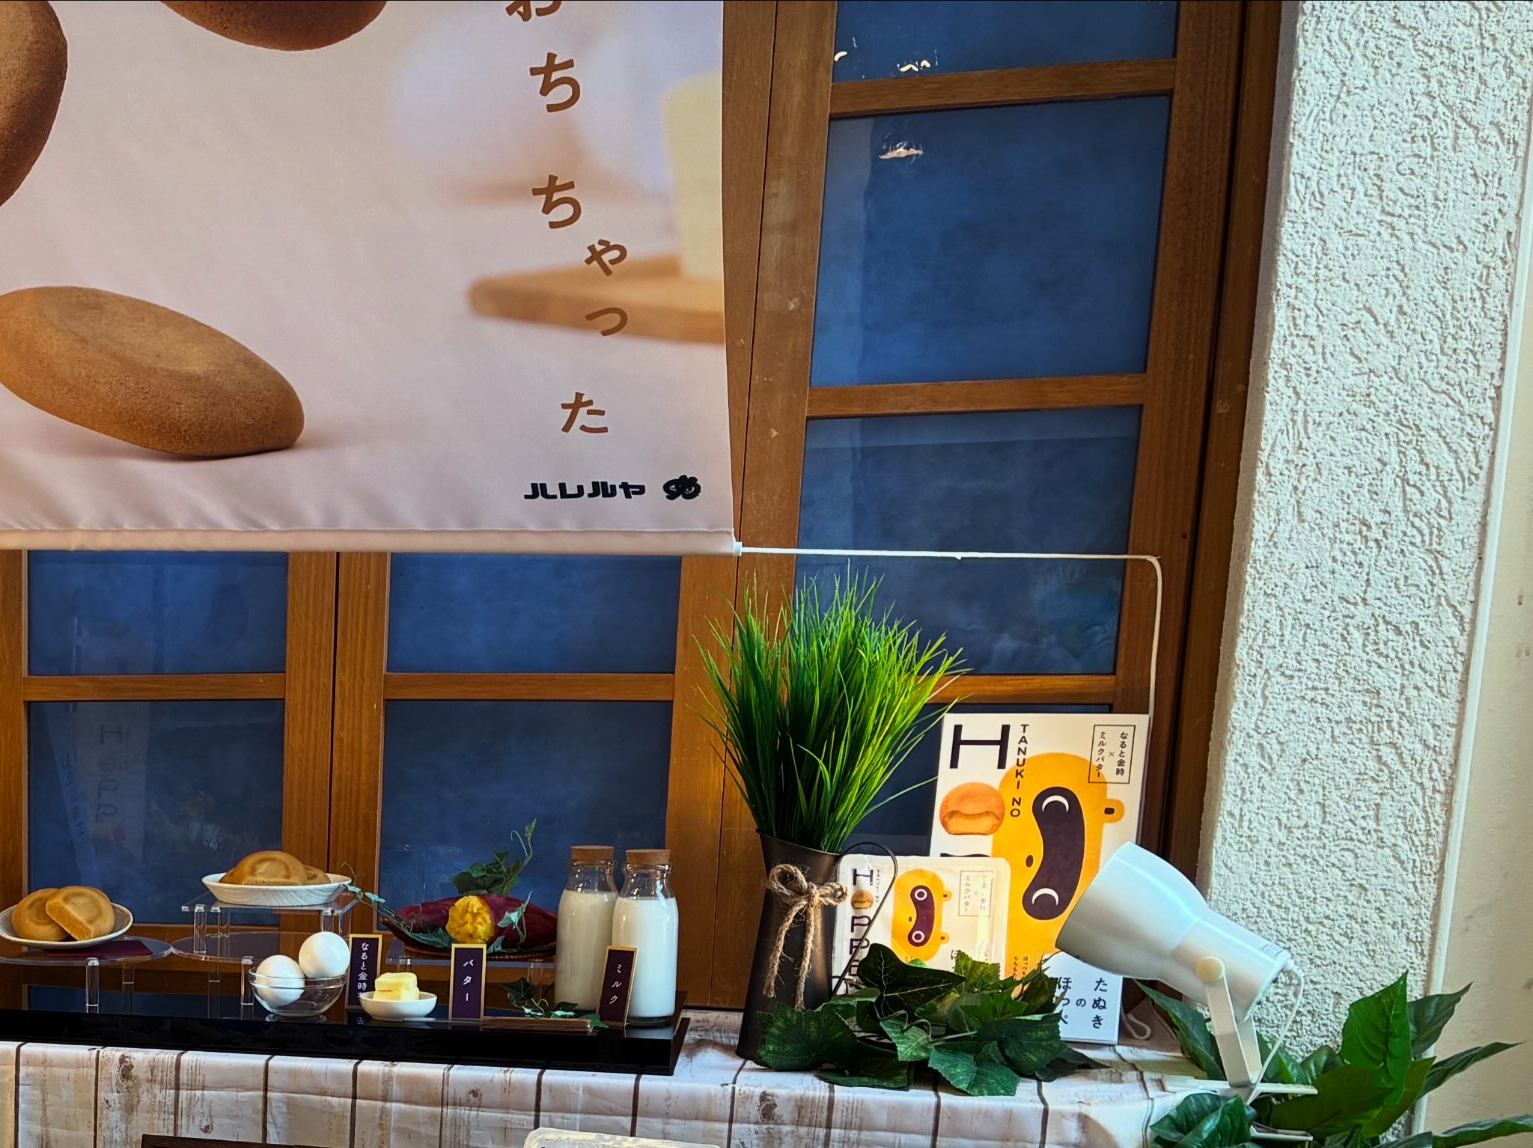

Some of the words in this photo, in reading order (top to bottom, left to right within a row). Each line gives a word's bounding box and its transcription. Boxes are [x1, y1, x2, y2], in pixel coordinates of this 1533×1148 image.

[524, 480, 646, 500] ハレルヤ
[1014, 723, 1030, 790] TANUKI
[1096, 730, 1108, 779] ミルクバター
[1115, 730, 1129, 776] なると金時
[462, 957, 475, 1002] バター
[607, 962, 624, 1007] ミルク
